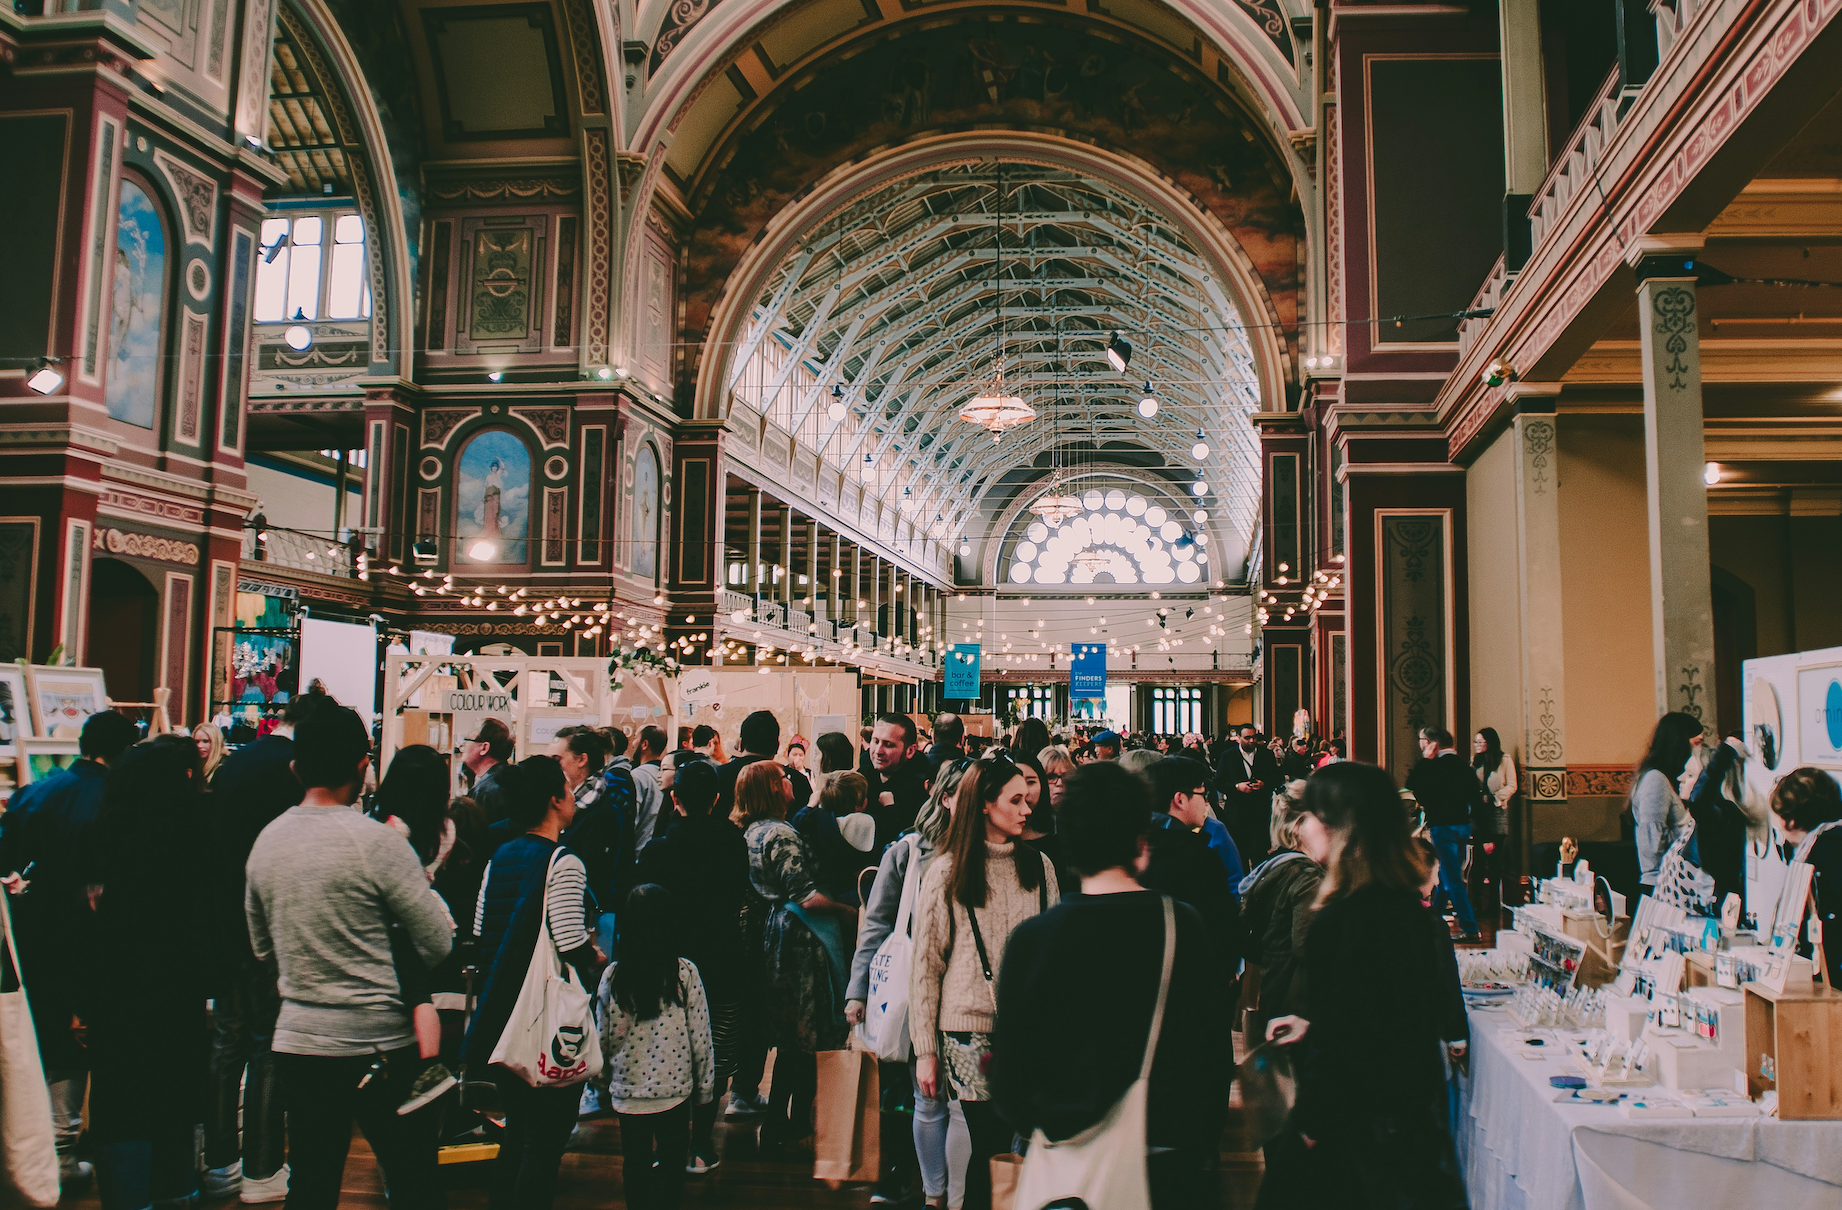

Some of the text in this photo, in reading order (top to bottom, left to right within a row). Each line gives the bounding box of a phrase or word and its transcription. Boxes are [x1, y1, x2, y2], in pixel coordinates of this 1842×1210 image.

[686, 681, 711, 696] frankie
[450, 693, 511, 712] COLOUR WORK
